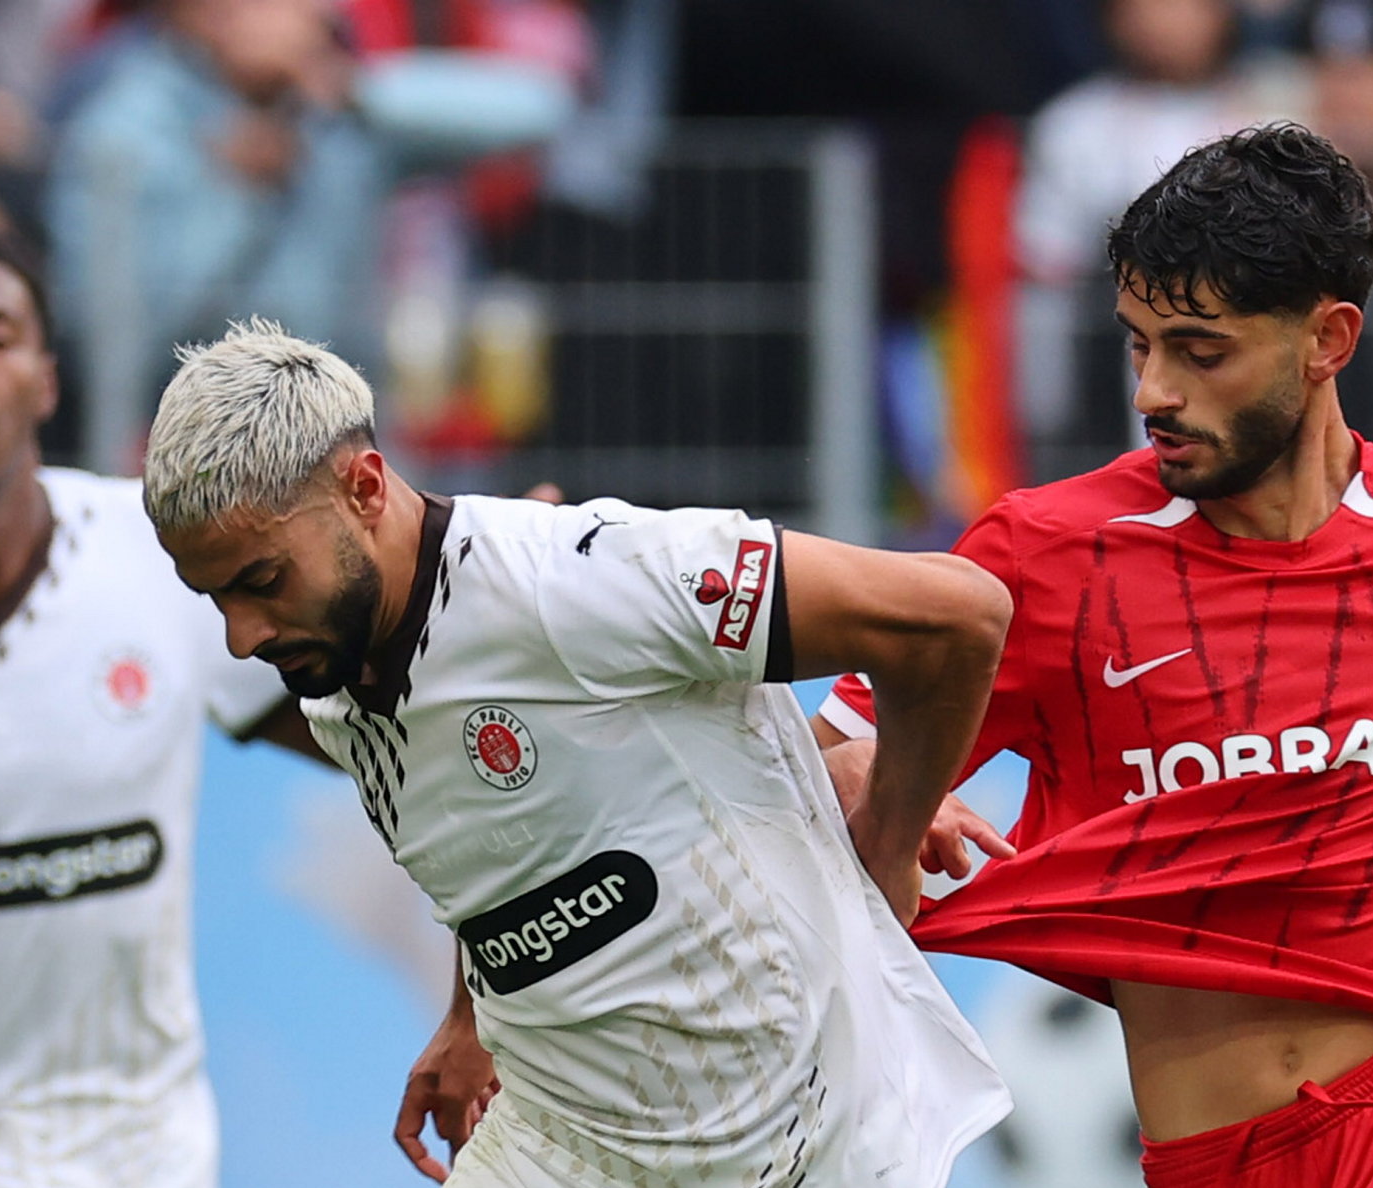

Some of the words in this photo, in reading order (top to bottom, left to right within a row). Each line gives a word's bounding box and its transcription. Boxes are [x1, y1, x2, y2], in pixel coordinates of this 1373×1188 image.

[723, 549, 765, 643] ASTRA
[466, 722, 481, 740] ST.
[479, 709, 523, 735] PAULI
[503, 765, 530, 788] 1910
[476, 873, 626, 969] congstar
